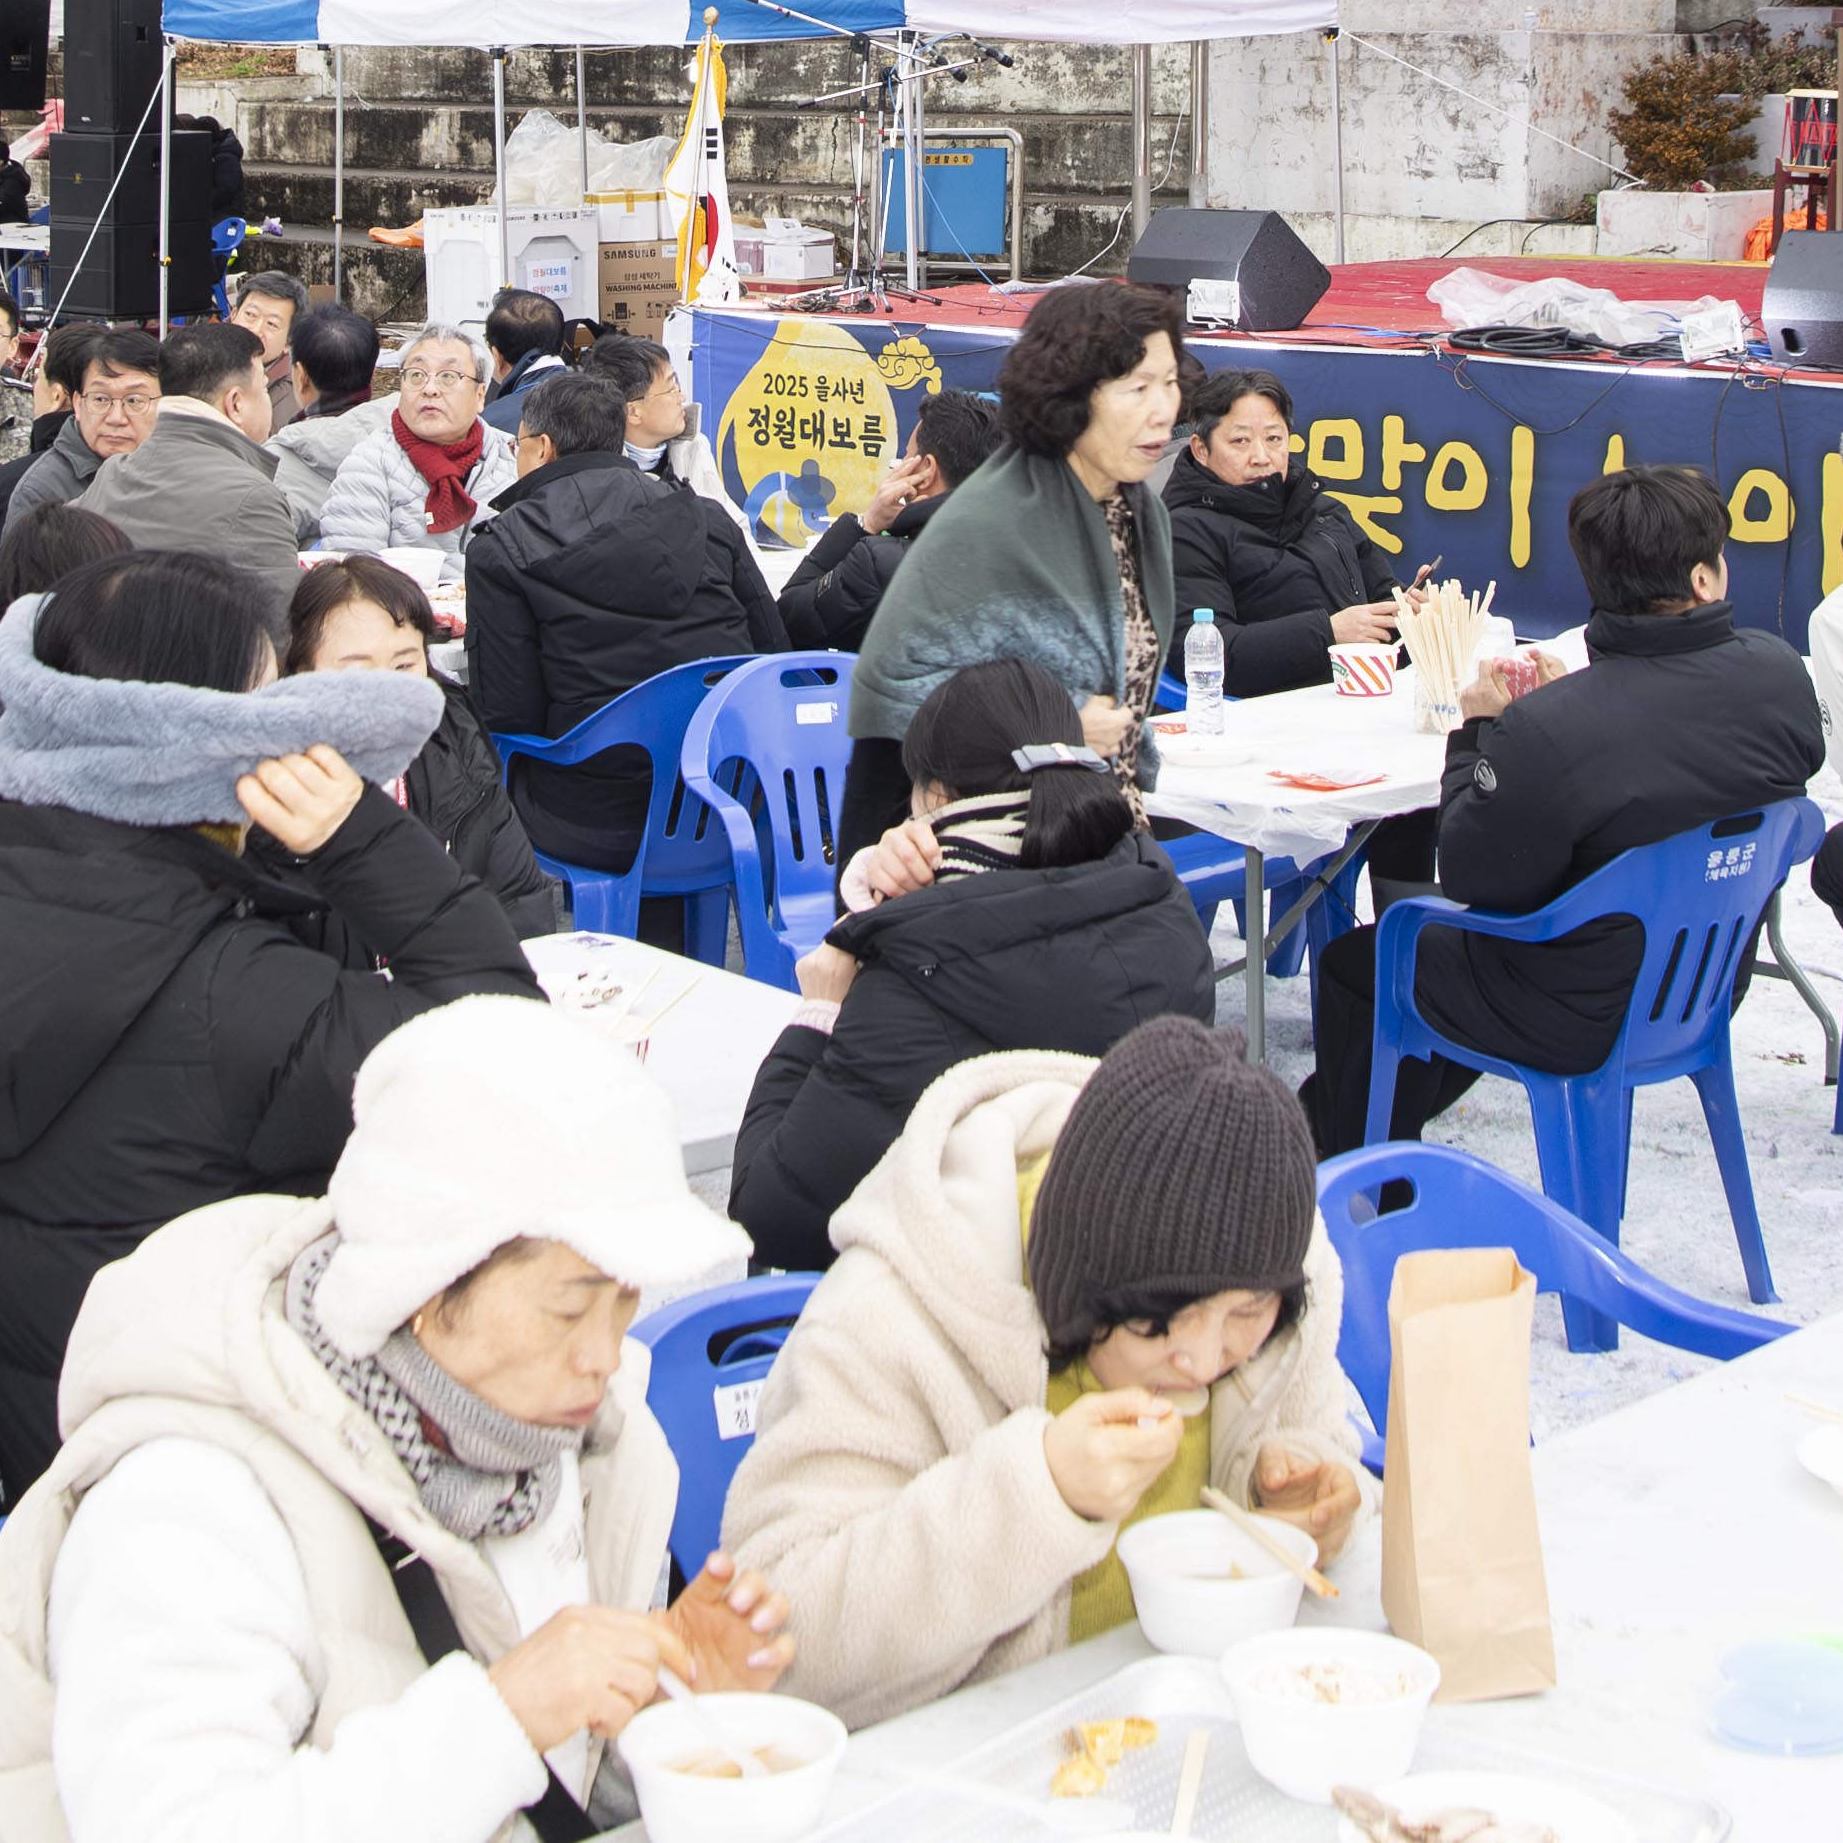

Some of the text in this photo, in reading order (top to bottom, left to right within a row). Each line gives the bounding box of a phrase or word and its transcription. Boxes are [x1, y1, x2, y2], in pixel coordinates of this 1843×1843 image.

[603, 248, 656, 260] SAMSUNG
[606, 283, 642, 292] WASHING
[763, 373, 864, 404] 2025 을사년
[748, 404, 886, 457] 정월대보름
[1289, 414, 1535, 568] 맞이
